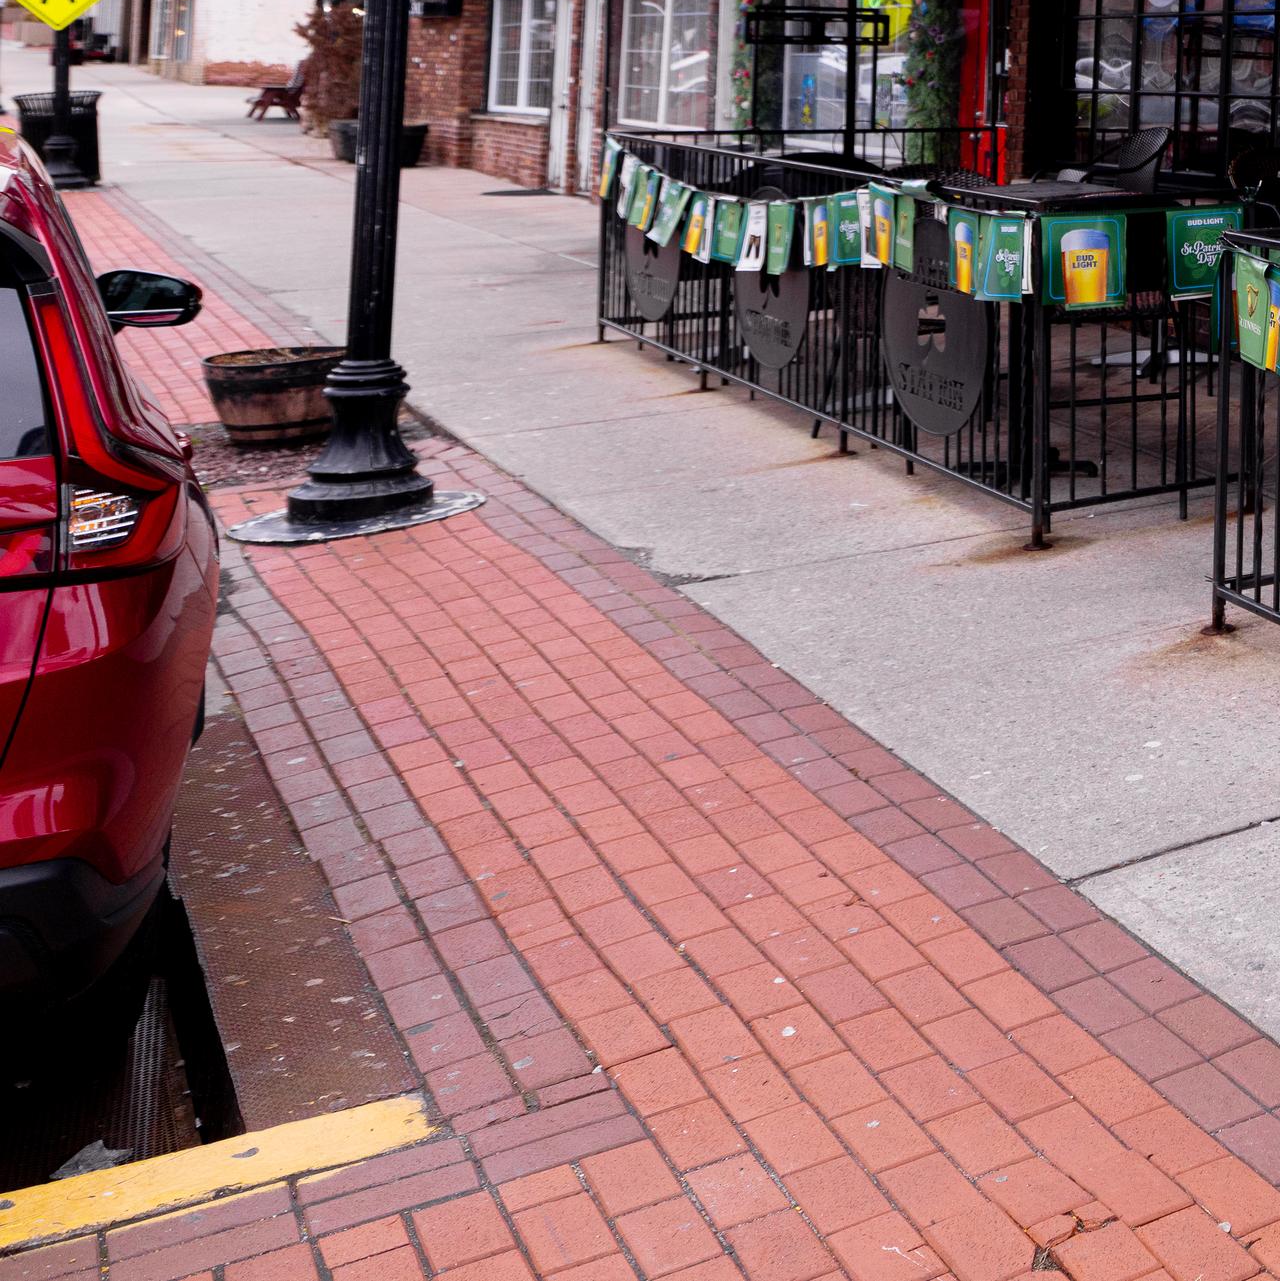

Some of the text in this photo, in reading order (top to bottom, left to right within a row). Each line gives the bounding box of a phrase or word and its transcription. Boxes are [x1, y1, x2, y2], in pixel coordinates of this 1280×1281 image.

[1203, 217, 1224, 225] LIGHT
[1075, 254, 1095, 262] BUD
[1196, 252, 1218, 266] Day
[1072, 260, 1098, 269] LIGHT
